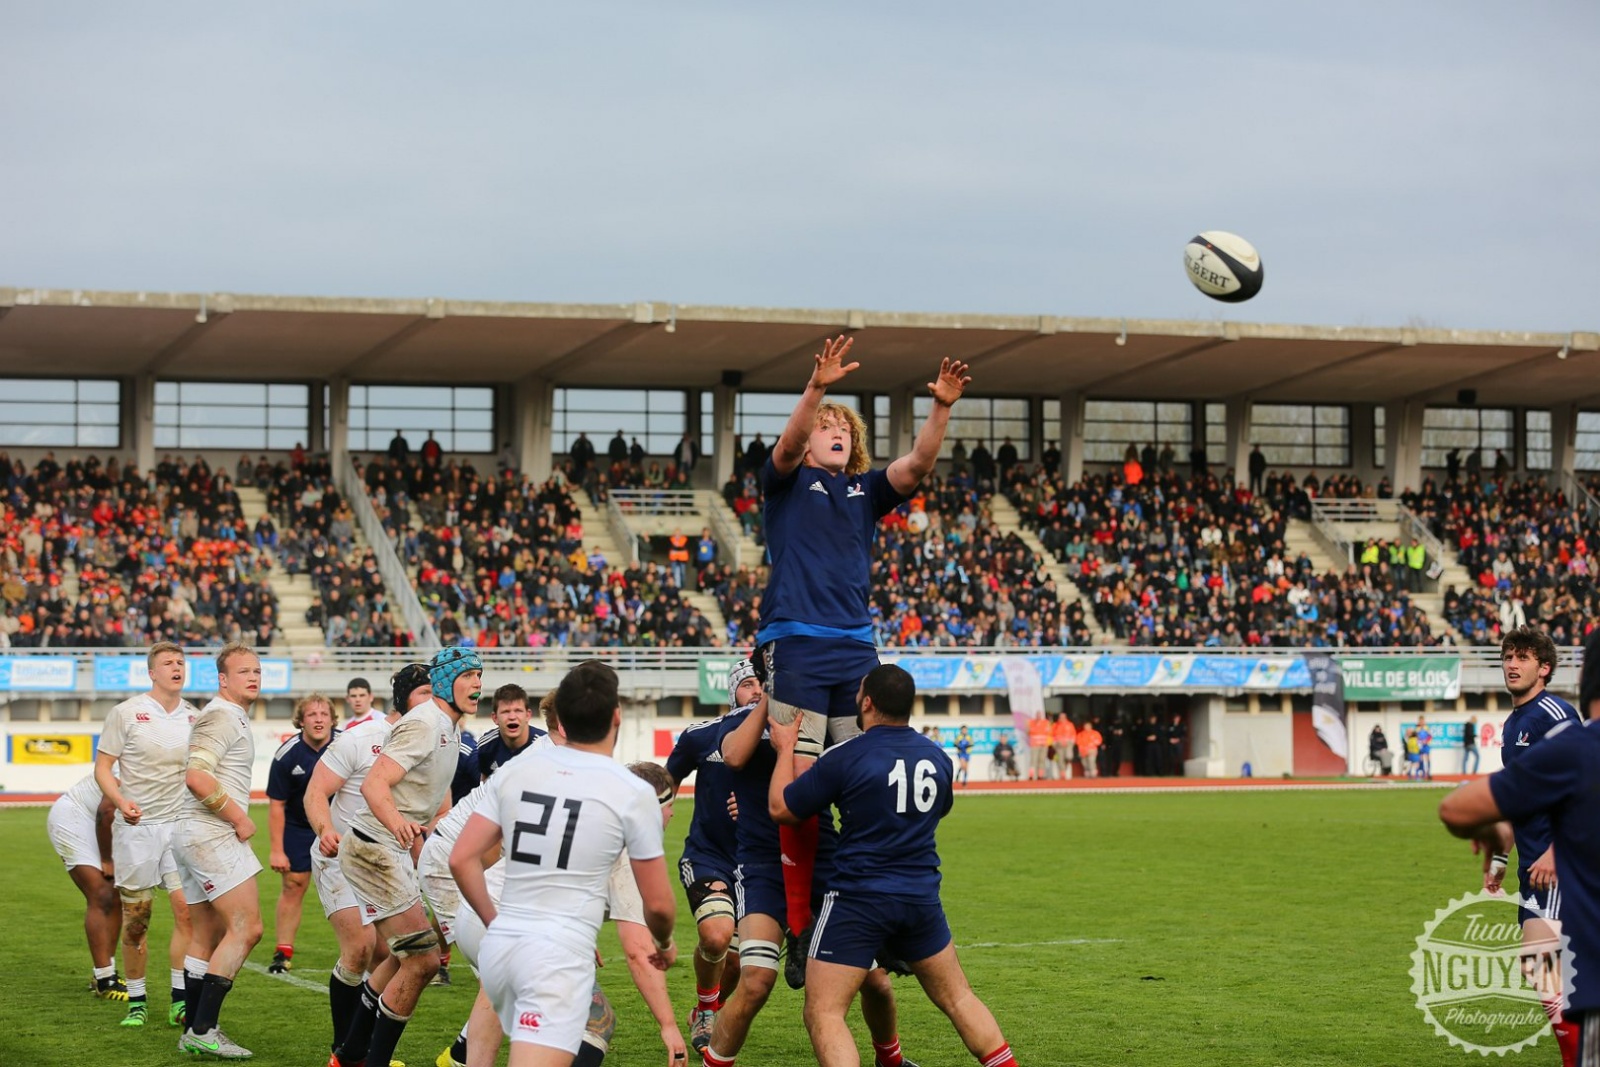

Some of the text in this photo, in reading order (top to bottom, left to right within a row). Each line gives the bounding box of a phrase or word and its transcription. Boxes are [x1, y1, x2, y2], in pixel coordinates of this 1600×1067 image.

[1343, 671, 1383, 688] VILLE
[1385, 671, 1405, 687] DE
[1408, 670, 1450, 687] BLOIS
[888, 759, 937, 813] 16
[511, 791, 582, 870] 21
